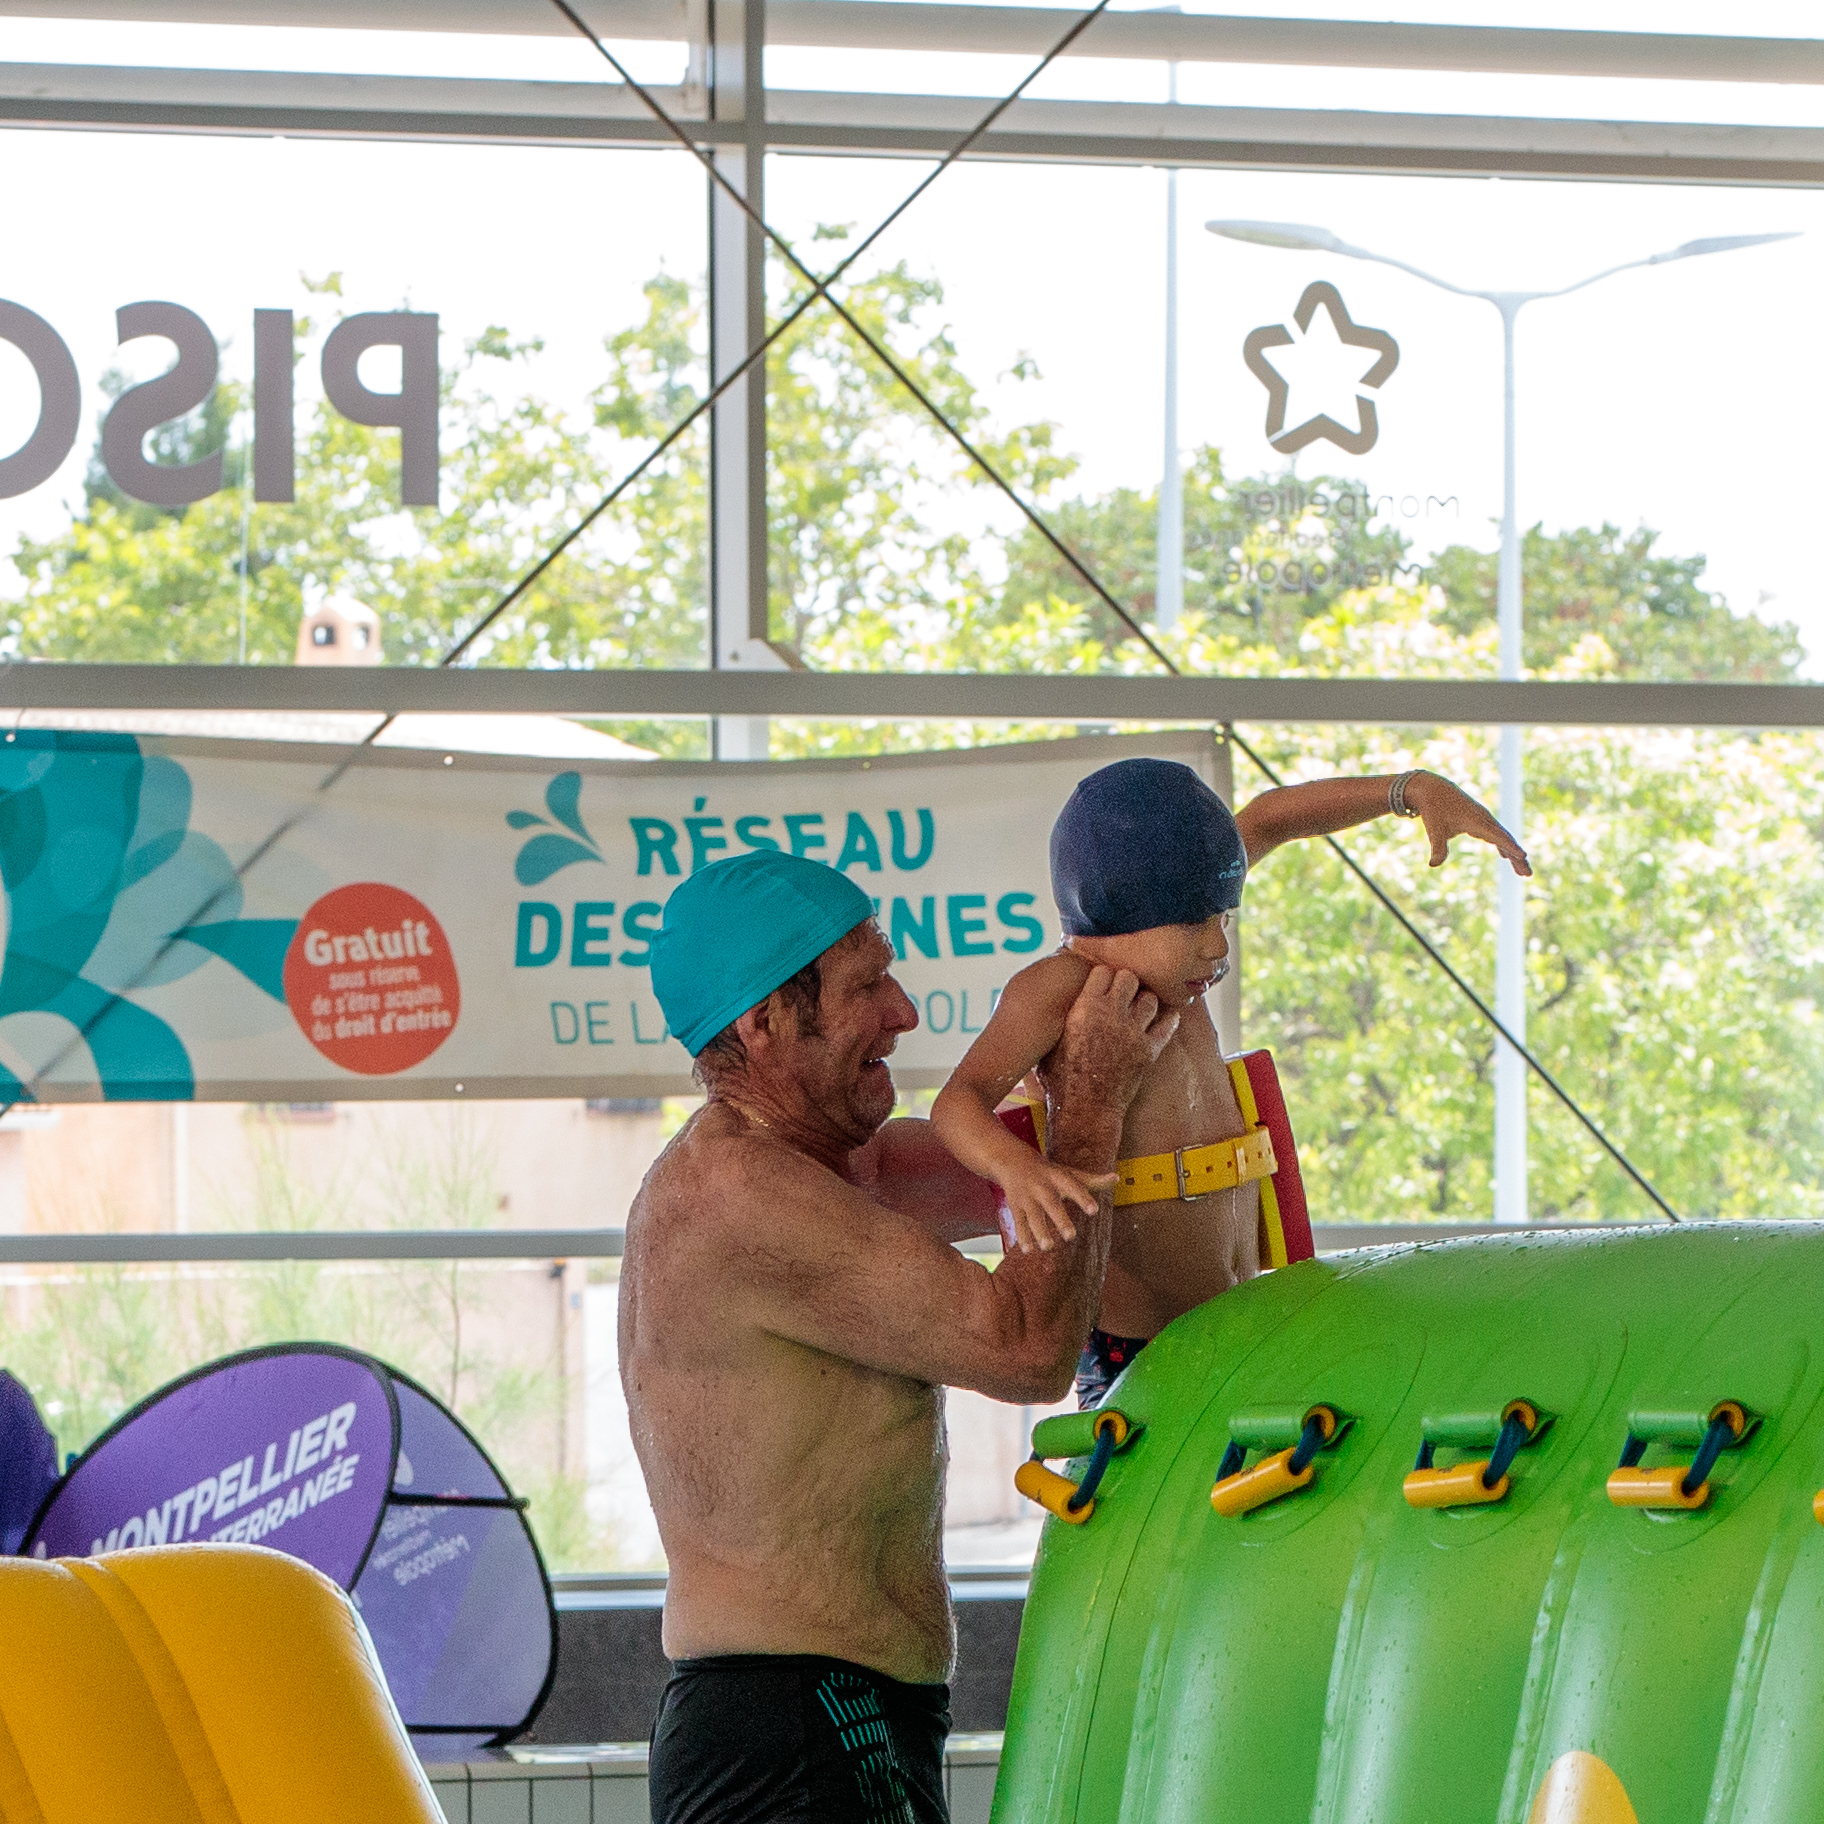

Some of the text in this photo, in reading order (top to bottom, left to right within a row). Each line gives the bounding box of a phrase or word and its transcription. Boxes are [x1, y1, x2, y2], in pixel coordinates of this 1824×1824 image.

[628, 797, 935, 876] RÉSEAU
[304, 919, 433, 966] Gratuit
[514, 900, 663, 968] DES
[550, 1000, 672, 1046] DE L
[210, 1453, 361, 1544] TERRANÉE
